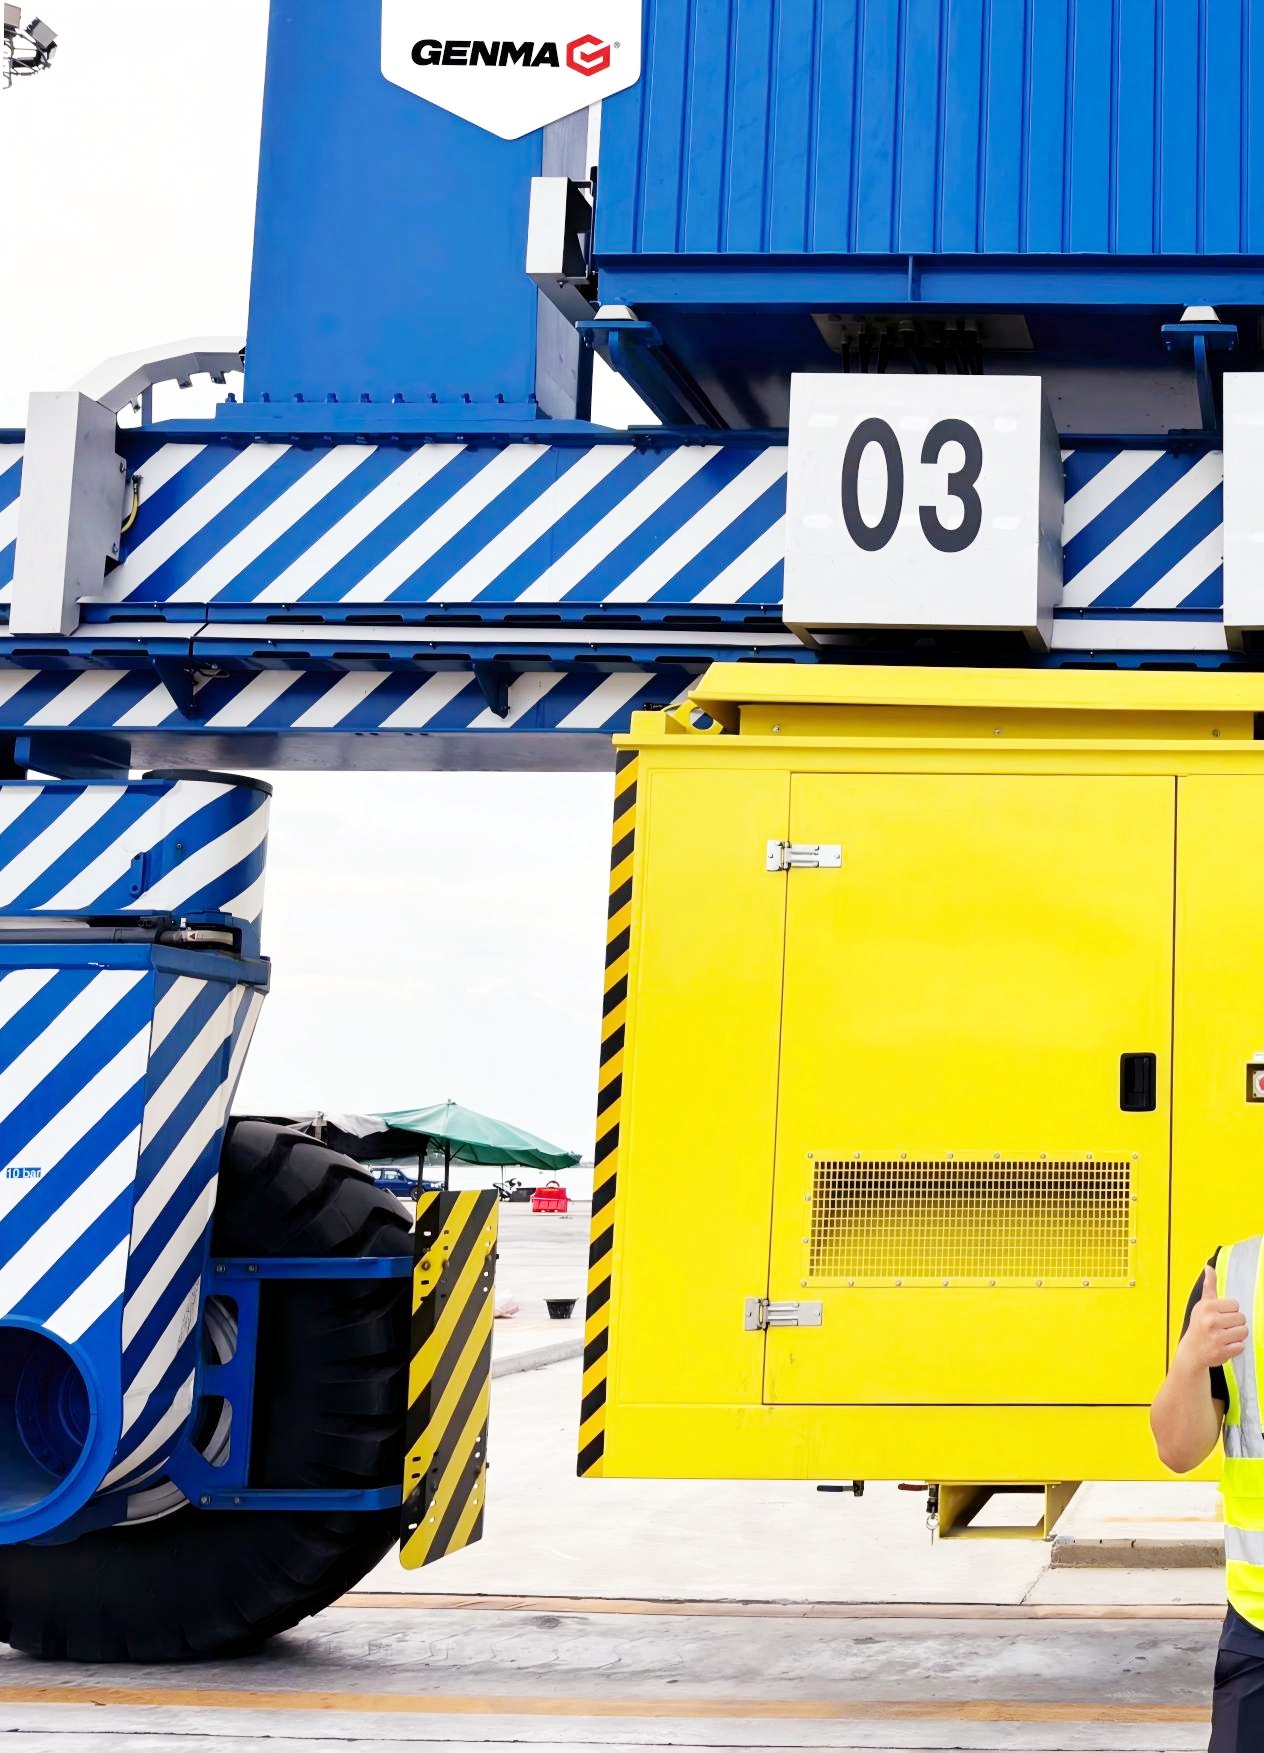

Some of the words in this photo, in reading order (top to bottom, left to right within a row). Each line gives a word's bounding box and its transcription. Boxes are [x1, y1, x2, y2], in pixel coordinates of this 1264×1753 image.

[411, 39, 560, 67] GENMA
[841, 417, 983, 553] 03
[7, 1167, 20, 1178] 10
[22, 1167, 41, 1178] bar
